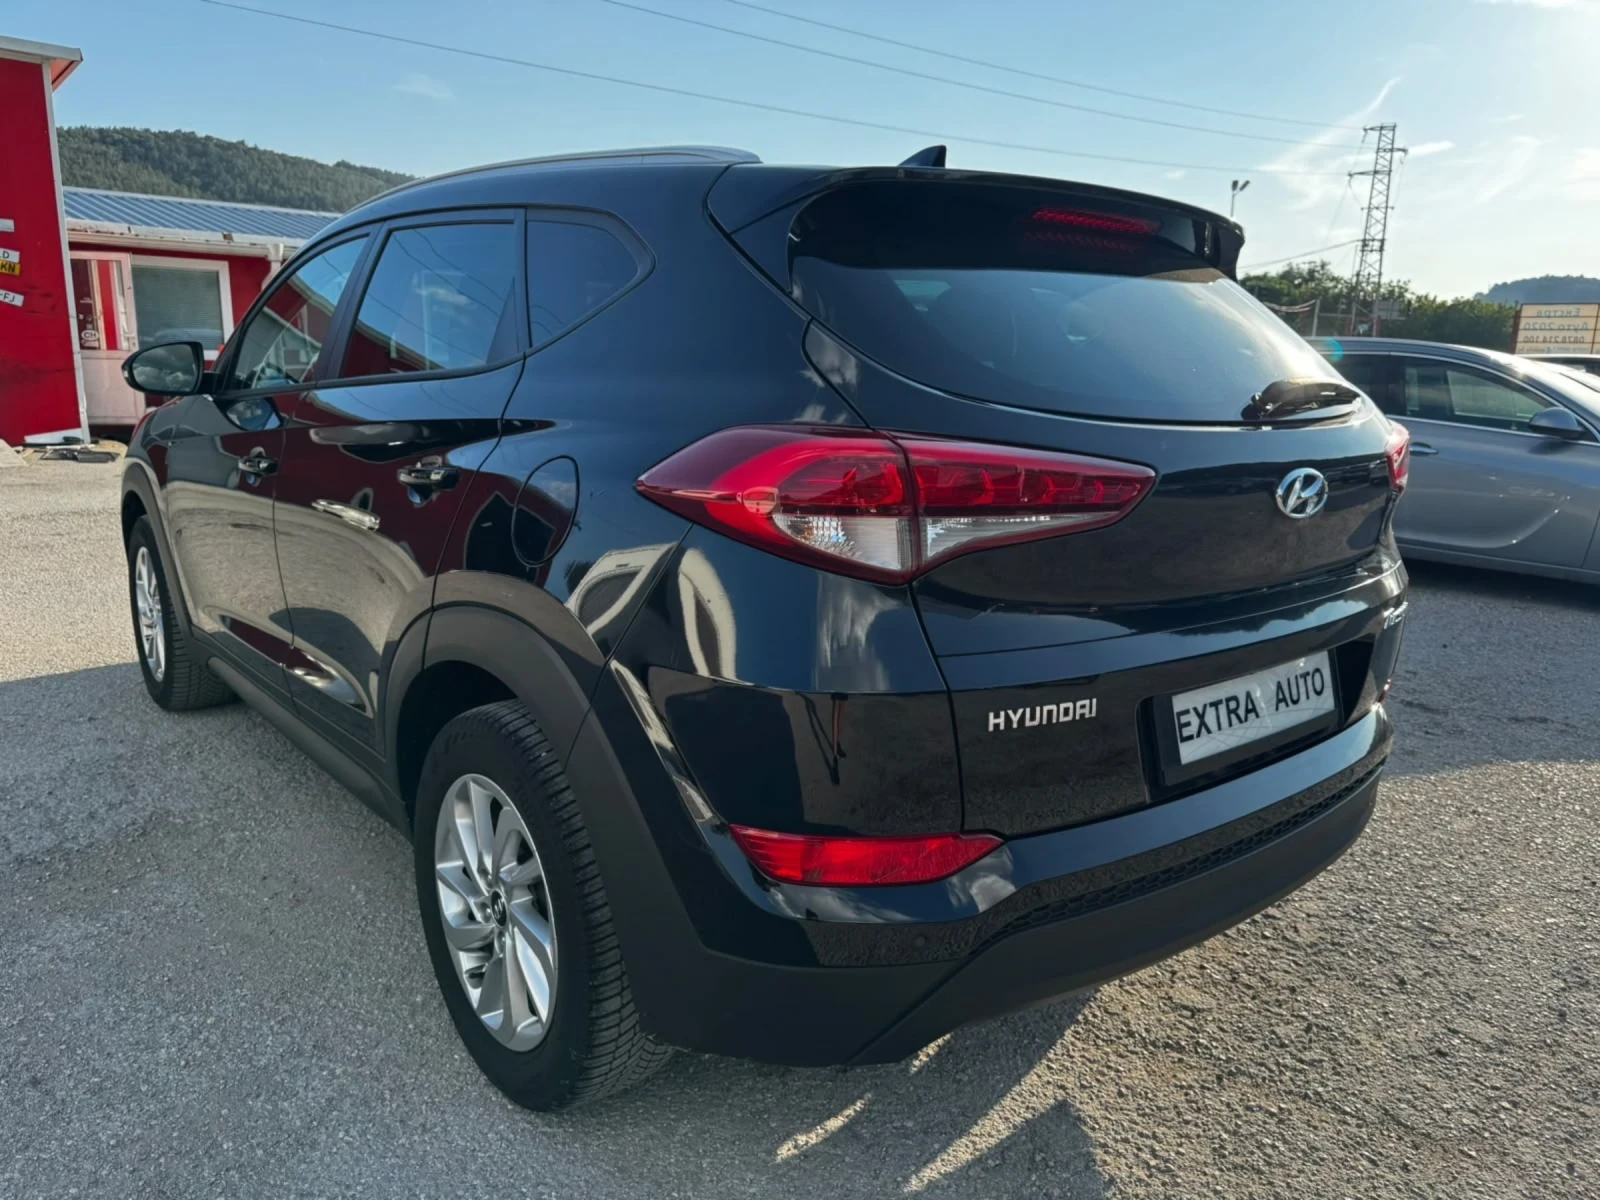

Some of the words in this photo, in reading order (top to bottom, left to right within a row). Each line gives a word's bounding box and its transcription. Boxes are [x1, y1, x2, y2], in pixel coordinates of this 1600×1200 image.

[988, 698, 1097, 732] HYUNDAI
[1176, 690, 1260, 743] EXTRA
[1275, 667, 1325, 711] AUTO
